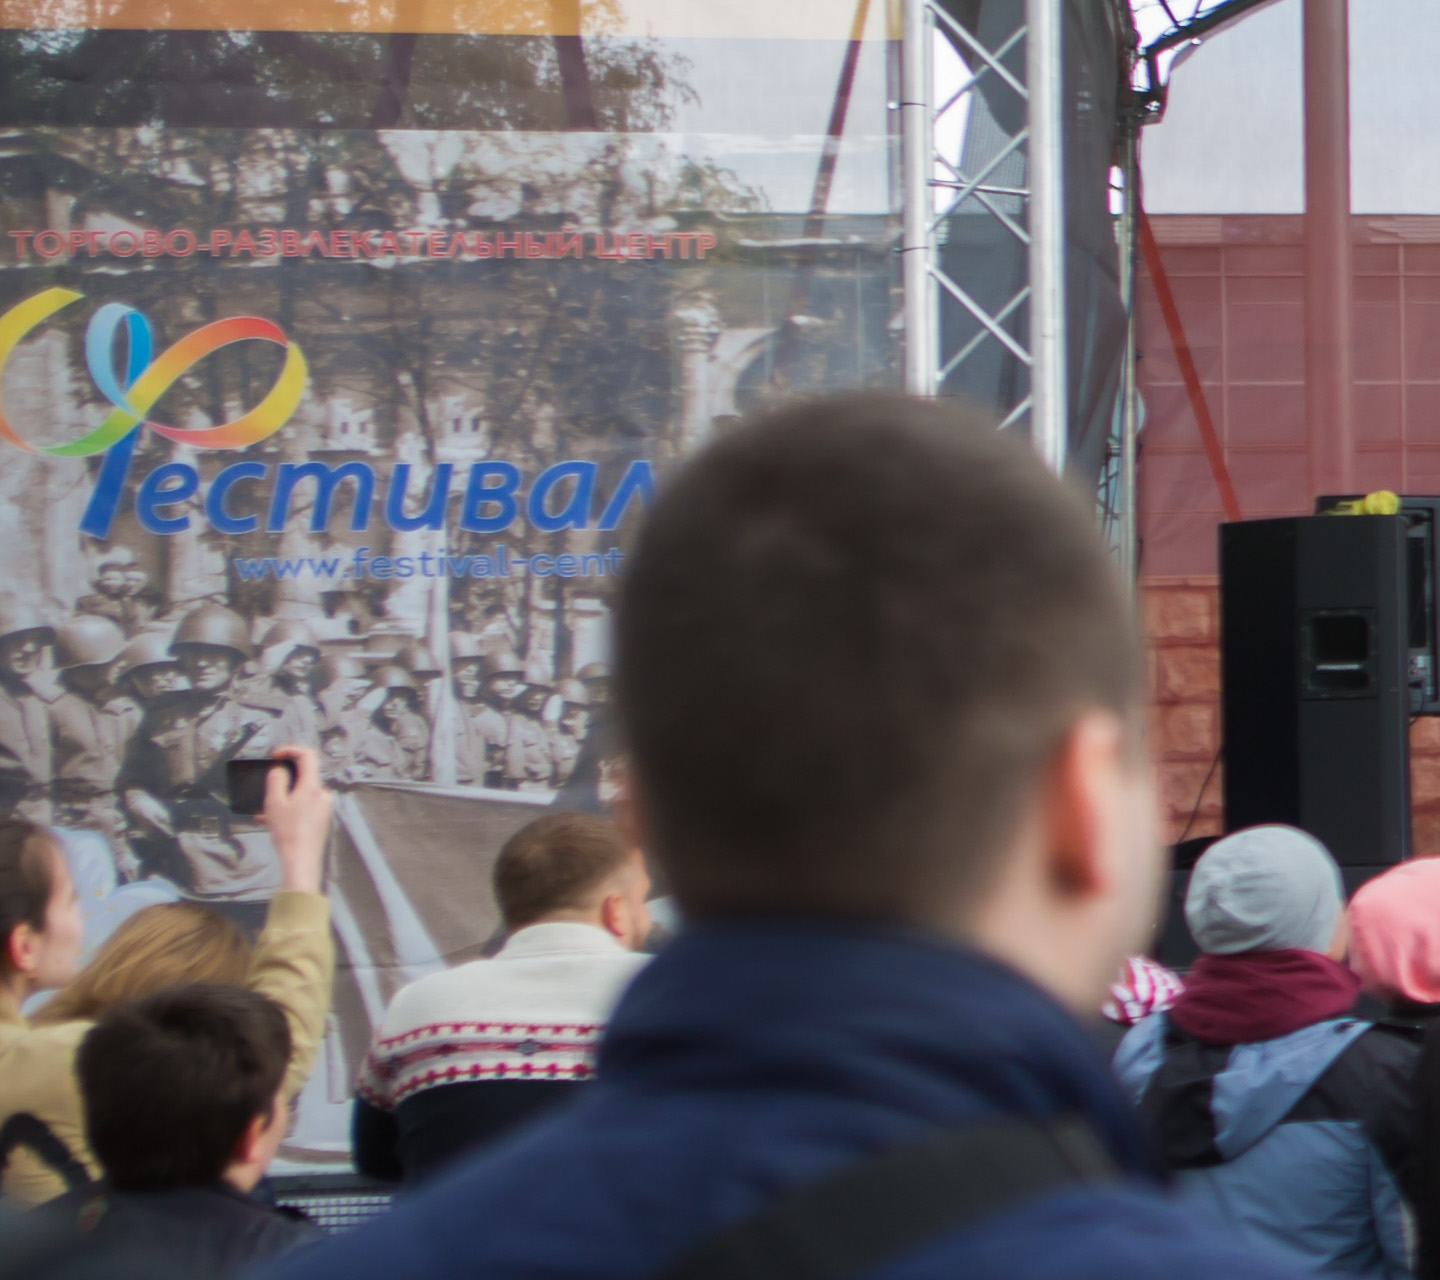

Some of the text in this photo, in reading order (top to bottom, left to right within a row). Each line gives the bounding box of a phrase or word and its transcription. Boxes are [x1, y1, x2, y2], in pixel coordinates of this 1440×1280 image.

[8, 230, 718, 264] ТОРГОВО-РАЗВЛЕКАТЕЛЬНЫЙ ЦЕНТР
[0, 286, 657, 540] Фестивал
[235, 547, 626, 582] www.festival-cent
